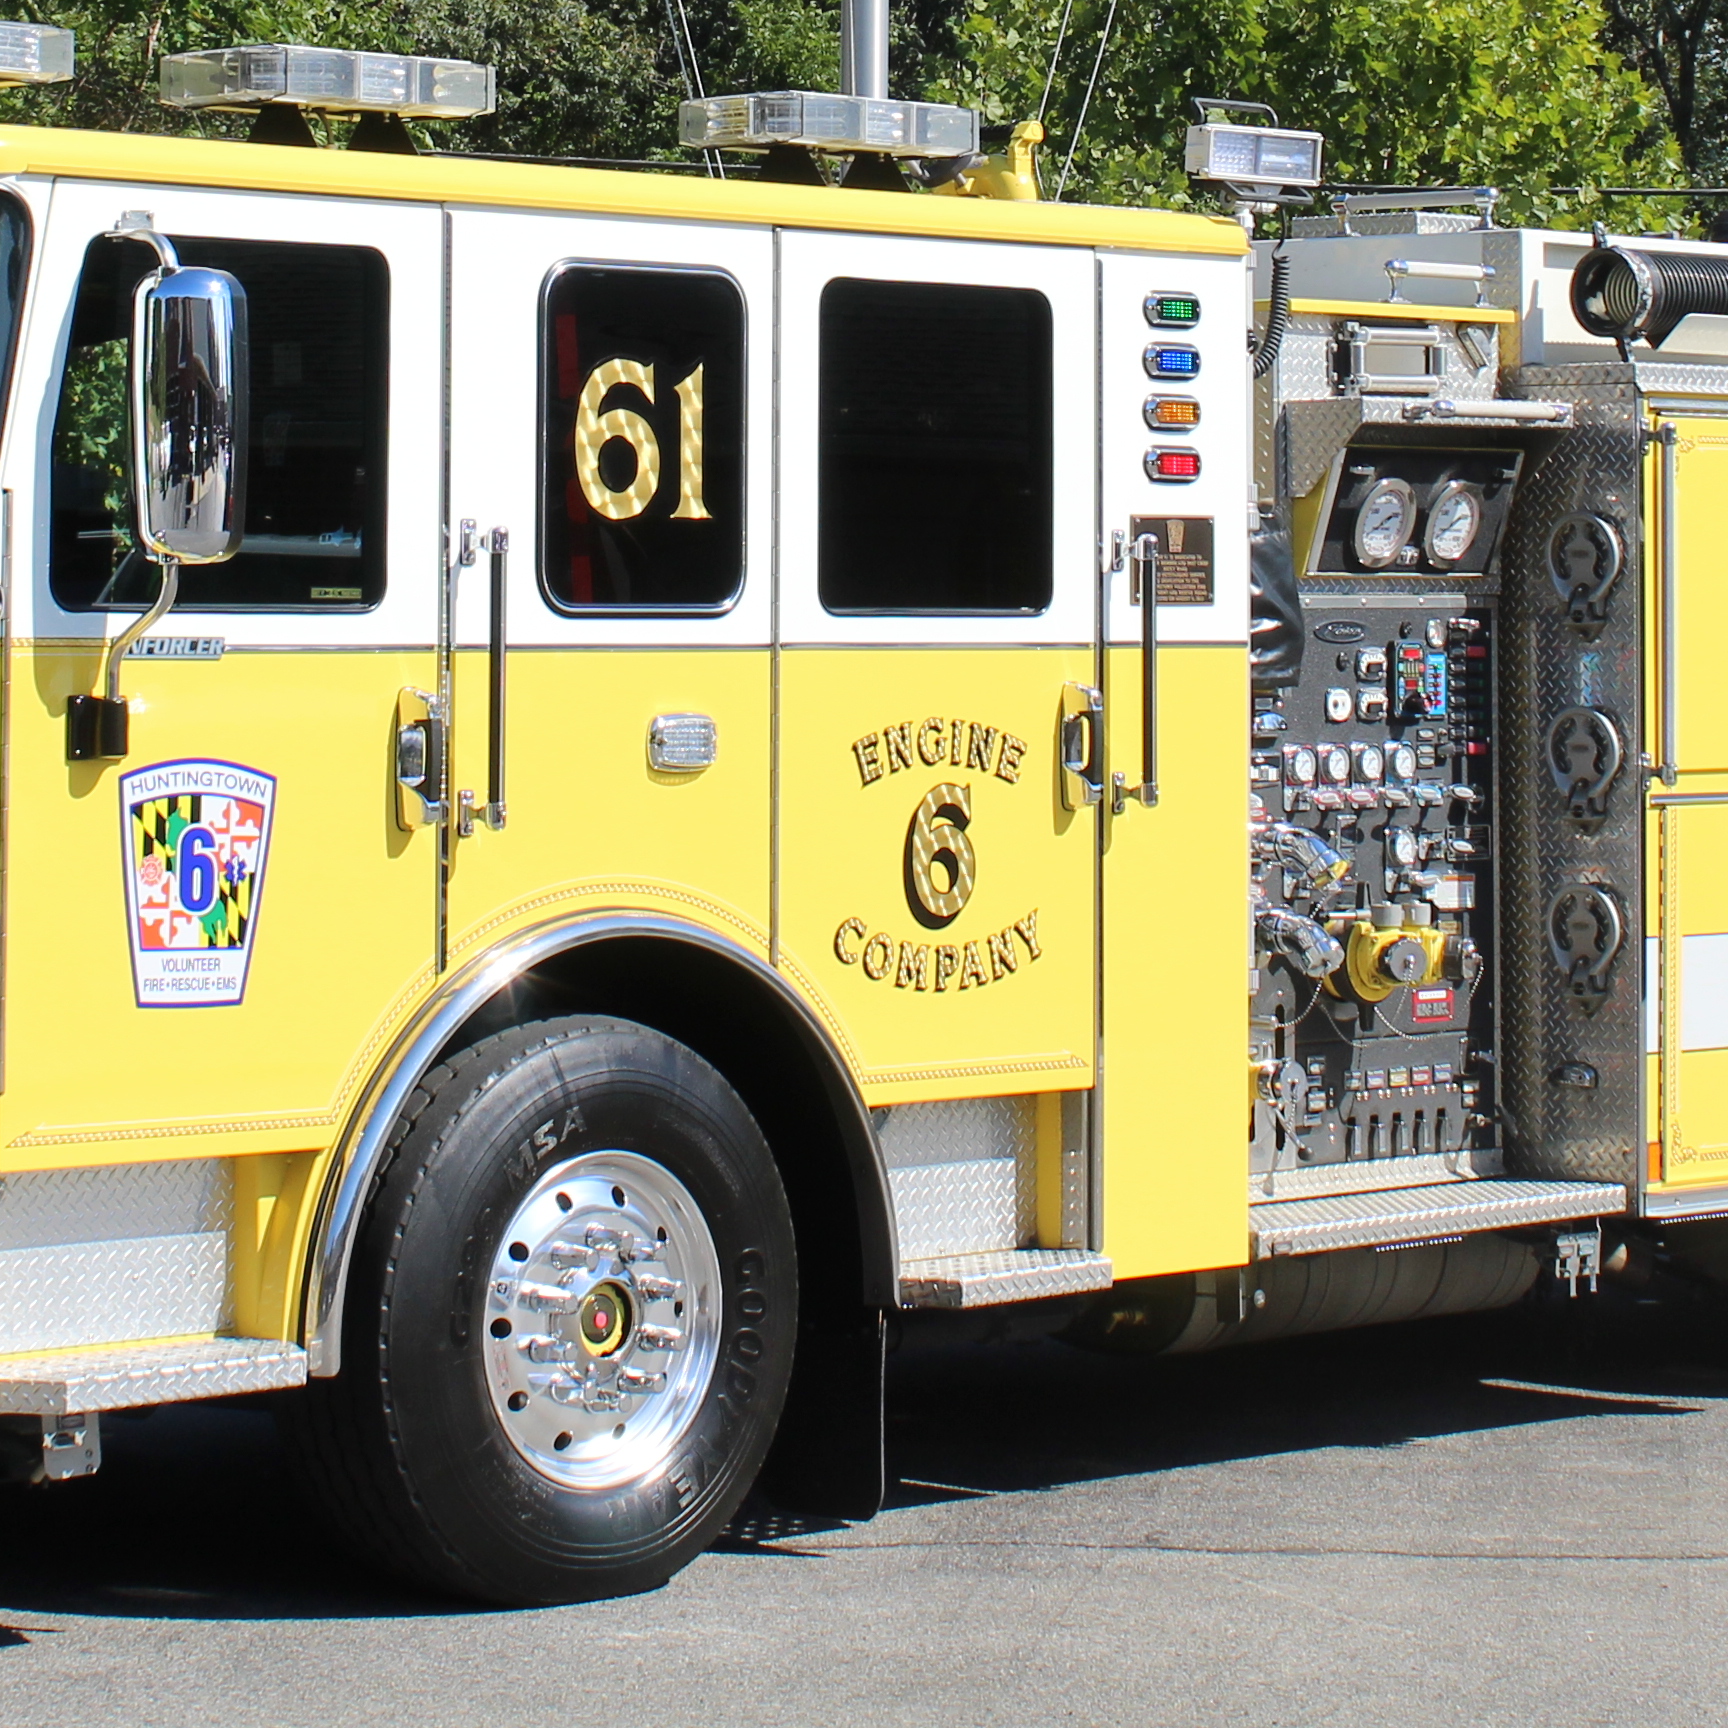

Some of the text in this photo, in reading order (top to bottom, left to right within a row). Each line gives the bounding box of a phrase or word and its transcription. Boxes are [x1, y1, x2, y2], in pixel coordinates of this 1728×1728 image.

[575, 358, 713, 521] 61
[127, 637, 224, 656] NFORCER
[130, 770, 268, 799] HUNTINGTOWN
[852, 716, 1028, 790] ENGINE
[179, 826, 217, 912] 6
[902, 782, 976, 931] 6
[161, 957, 221, 973] VOLUNTEER
[833, 907, 1043, 993] COMPANY
[502, 1105, 588, 1189] MSA
[606, 1247, 768, 1528] GOODYEAR
